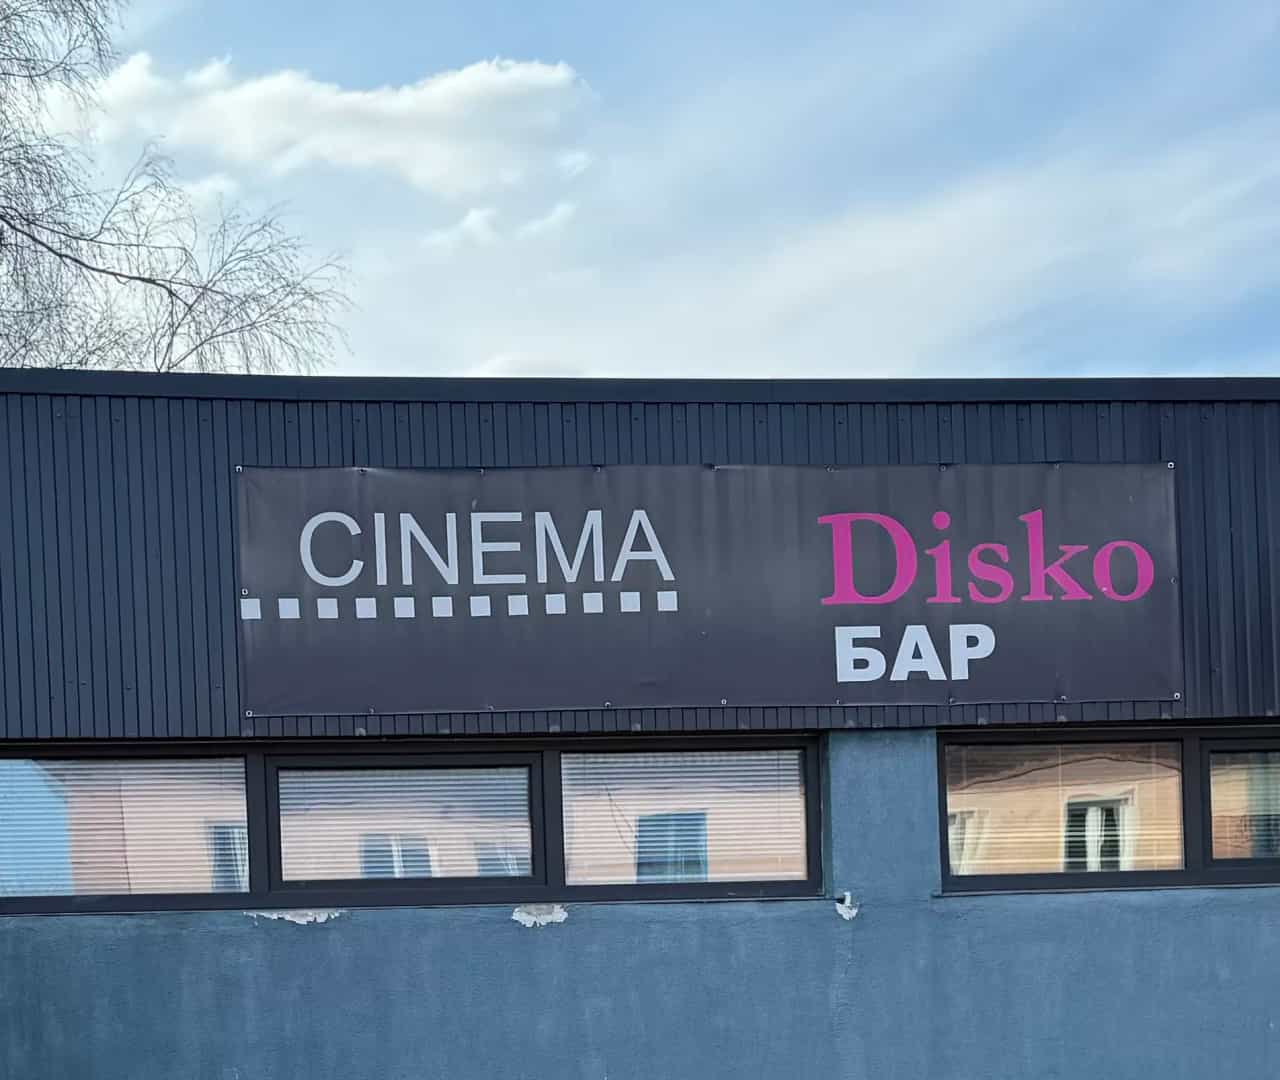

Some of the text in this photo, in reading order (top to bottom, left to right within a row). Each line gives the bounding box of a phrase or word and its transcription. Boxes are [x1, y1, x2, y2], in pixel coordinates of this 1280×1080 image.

[299, 509, 675, 588] CINEMA
[817, 509, 1155, 606] Disko
[834, 624, 996, 683] БАР
